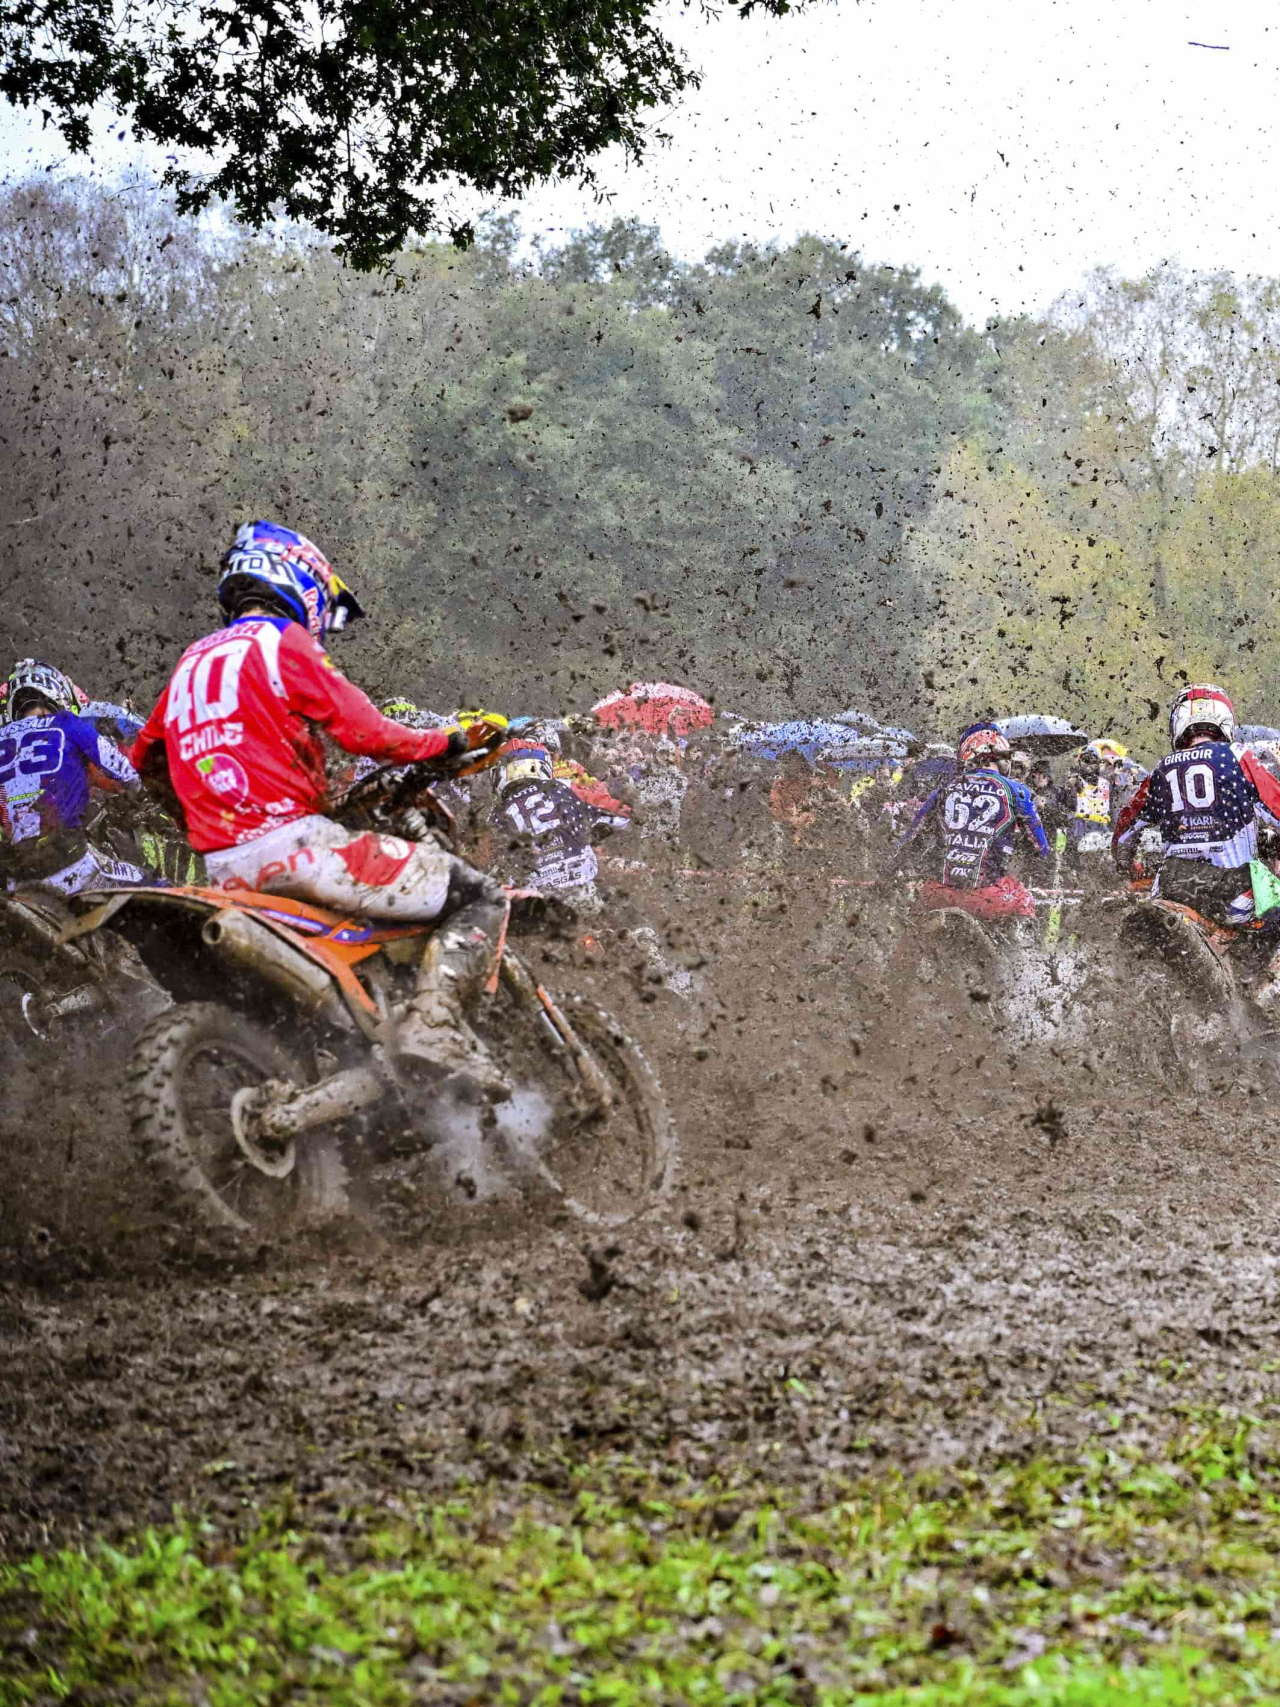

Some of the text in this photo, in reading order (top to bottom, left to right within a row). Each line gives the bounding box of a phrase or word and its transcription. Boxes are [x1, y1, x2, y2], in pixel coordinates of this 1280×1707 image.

[163, 639, 253, 734] 40
[0, 716, 56, 738] USSALY
[1164, 748, 1214, 767] GIRROIR
[1165, 763, 1216, 813] 10
[506, 792, 561, 835] 12
[944, 791, 1001, 835] 62
[945, 833, 988, 850] TALIA
[211, 847, 315, 892] even
[544, 871, 582, 891] ASGAS
